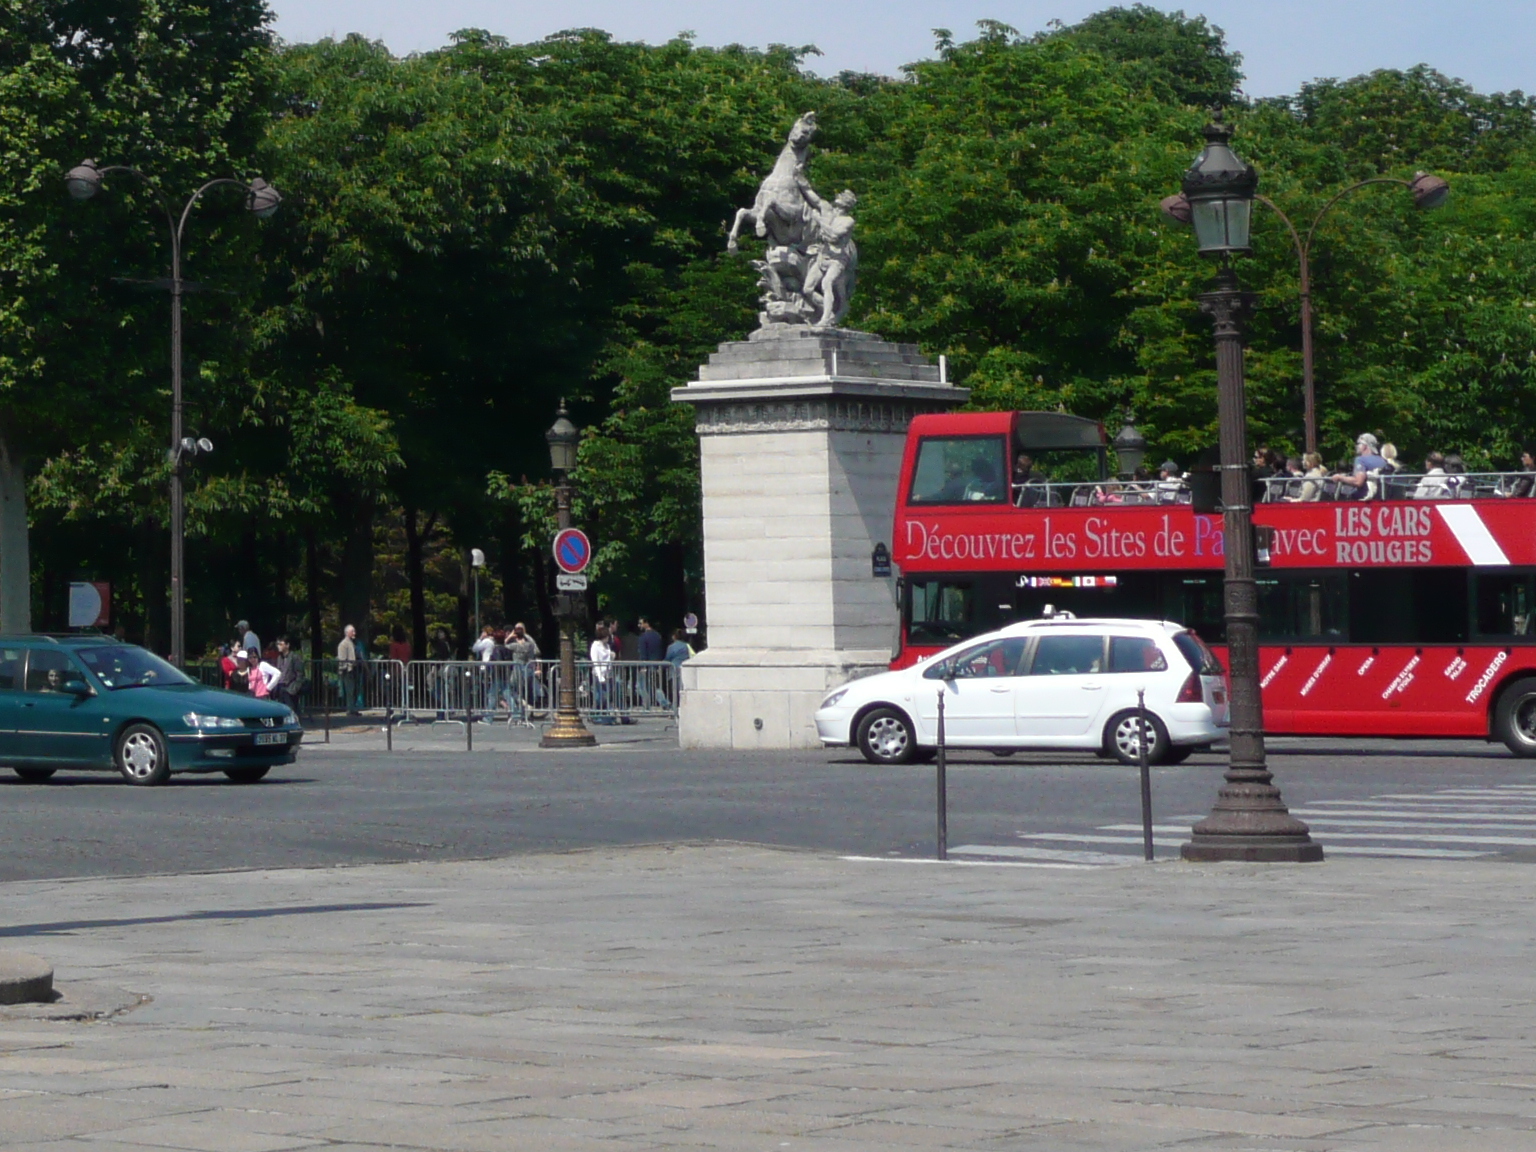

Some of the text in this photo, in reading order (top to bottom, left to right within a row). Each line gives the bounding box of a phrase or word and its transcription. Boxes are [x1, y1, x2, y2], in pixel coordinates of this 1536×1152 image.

[906, 520, 1035, 559] Découvrez
[1044, 517, 1076, 558] les
[1085, 517, 1145, 558] Sites
[1154, 514, 1184, 557] de
[1335, 506, 1432, 537] LES CARS
[1335, 540, 1432, 563] ROUGES
[1465, 651, 1507, 704] TROCADERO
